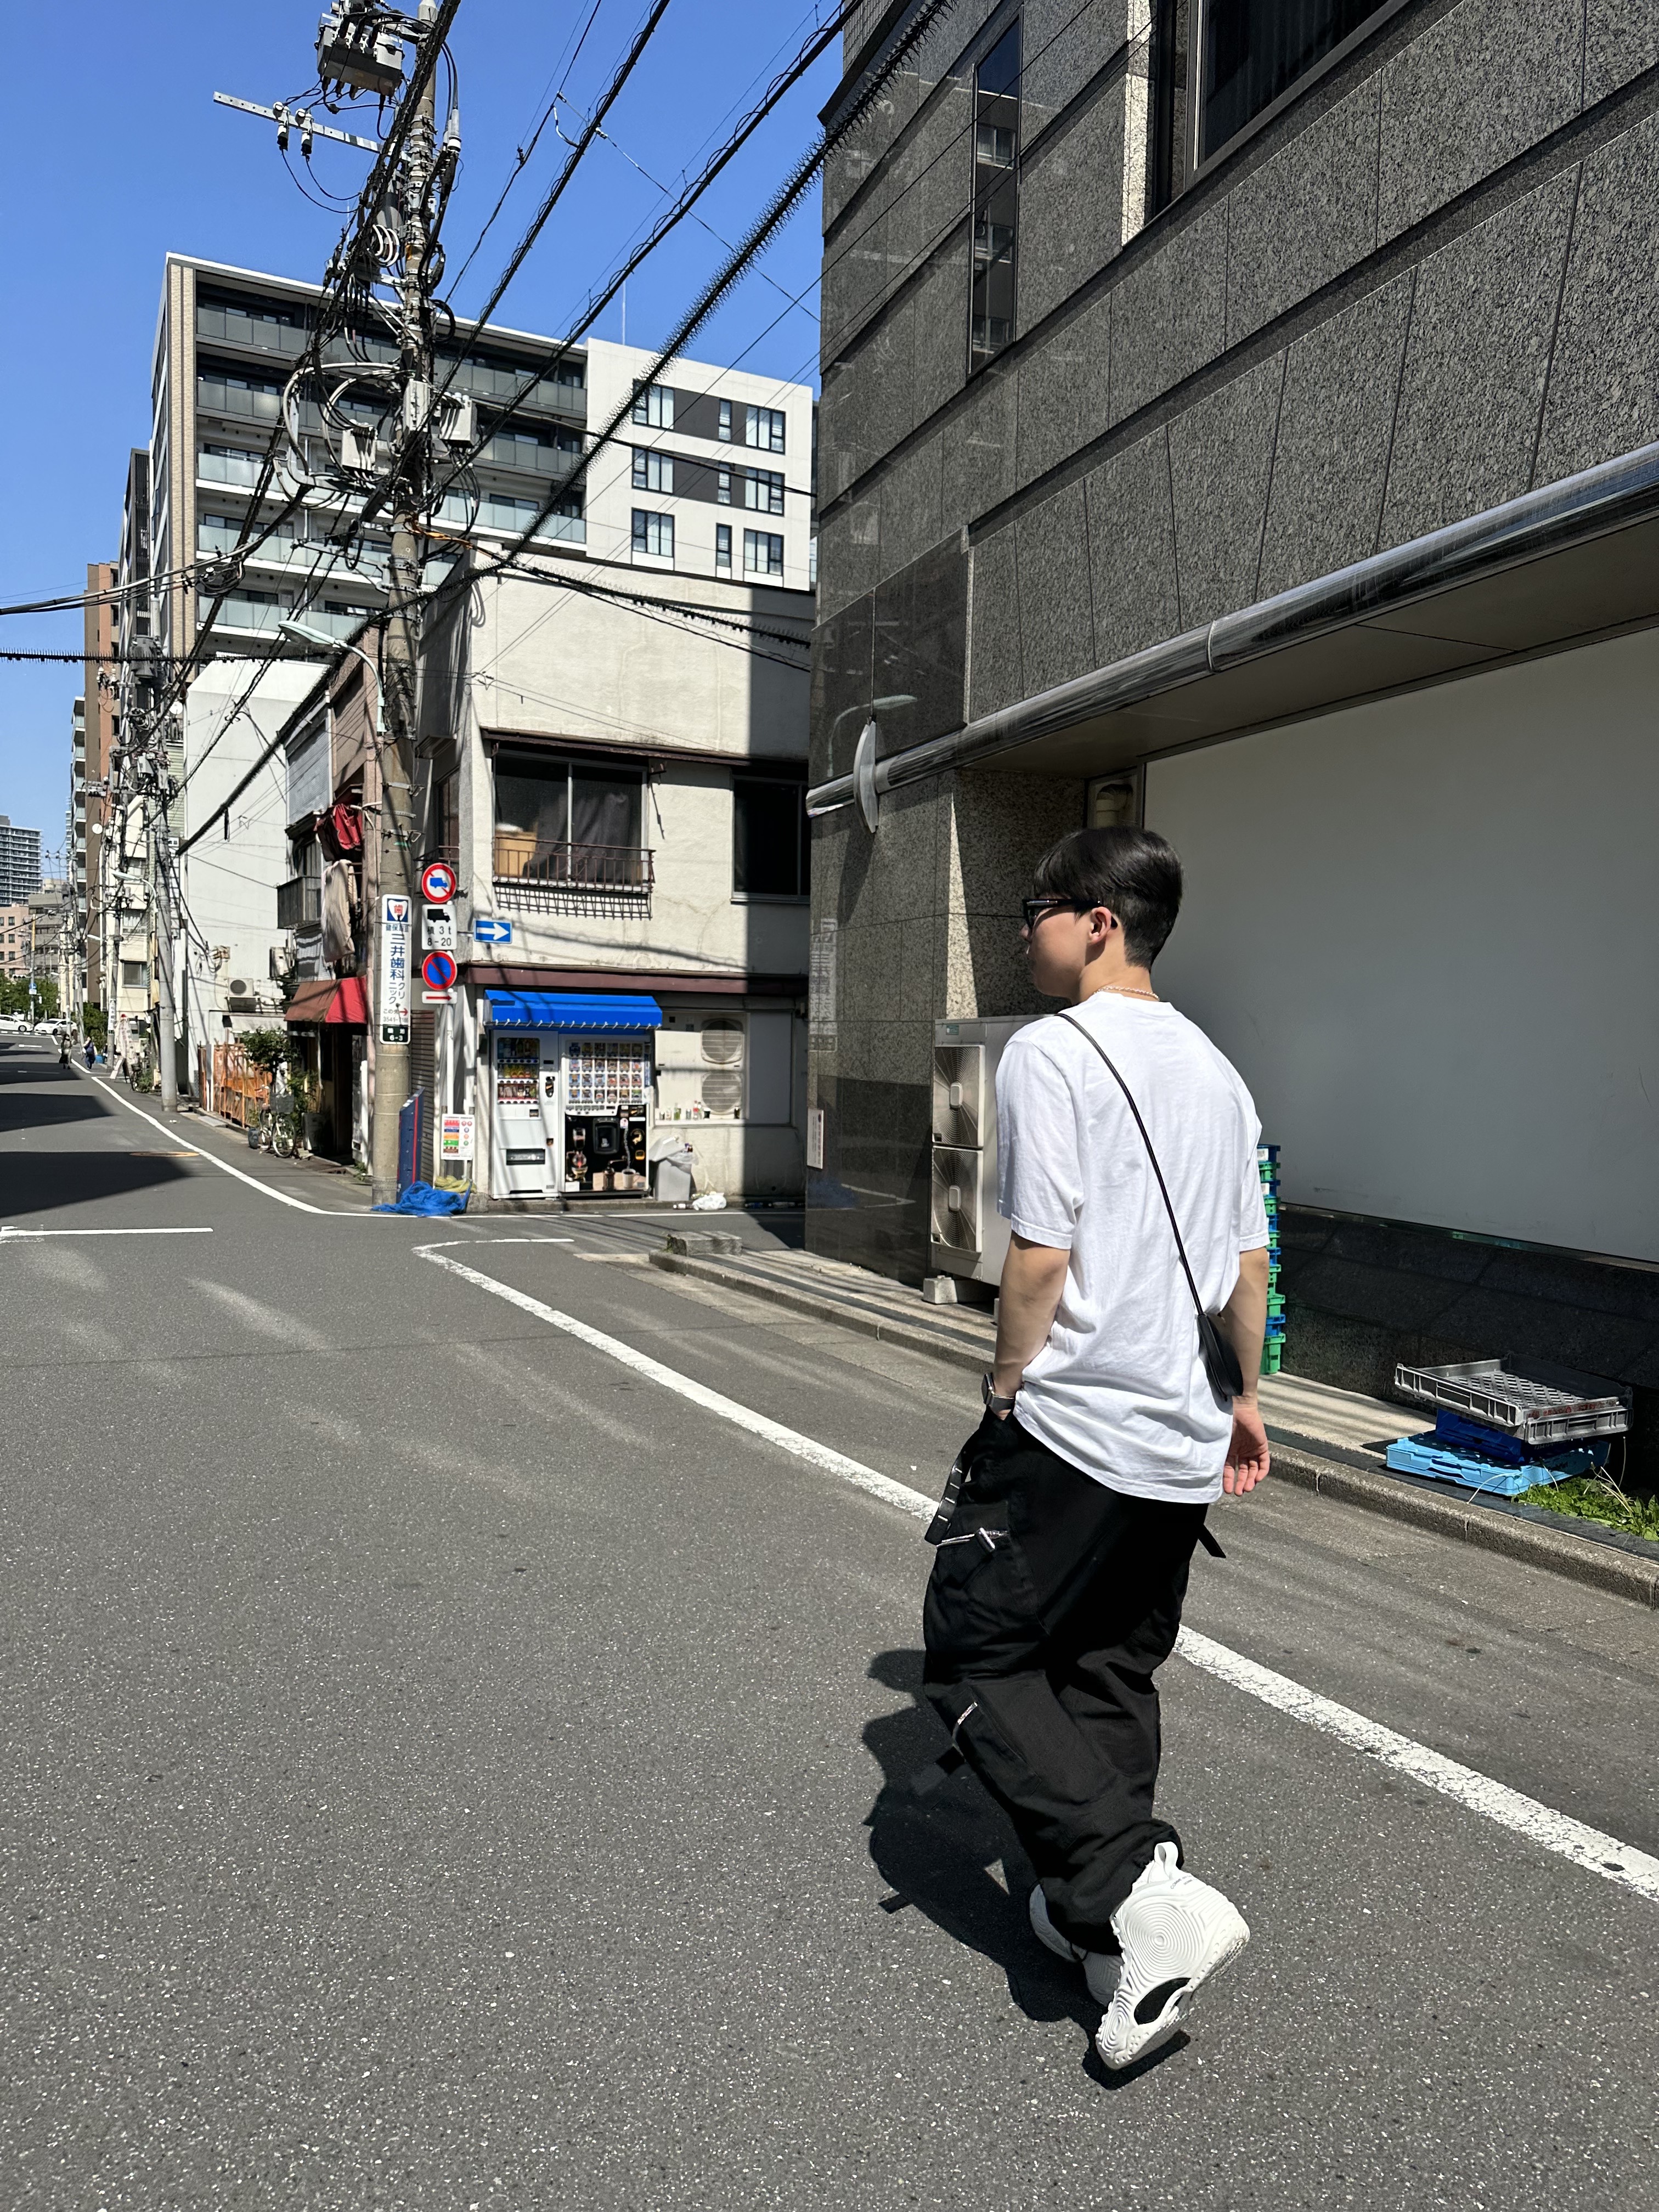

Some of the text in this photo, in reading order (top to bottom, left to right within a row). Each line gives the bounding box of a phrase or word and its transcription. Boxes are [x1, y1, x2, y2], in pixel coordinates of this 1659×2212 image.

[427, 938, 452, 946] 8-20
[390, 933, 405, 981] 三井歯科
